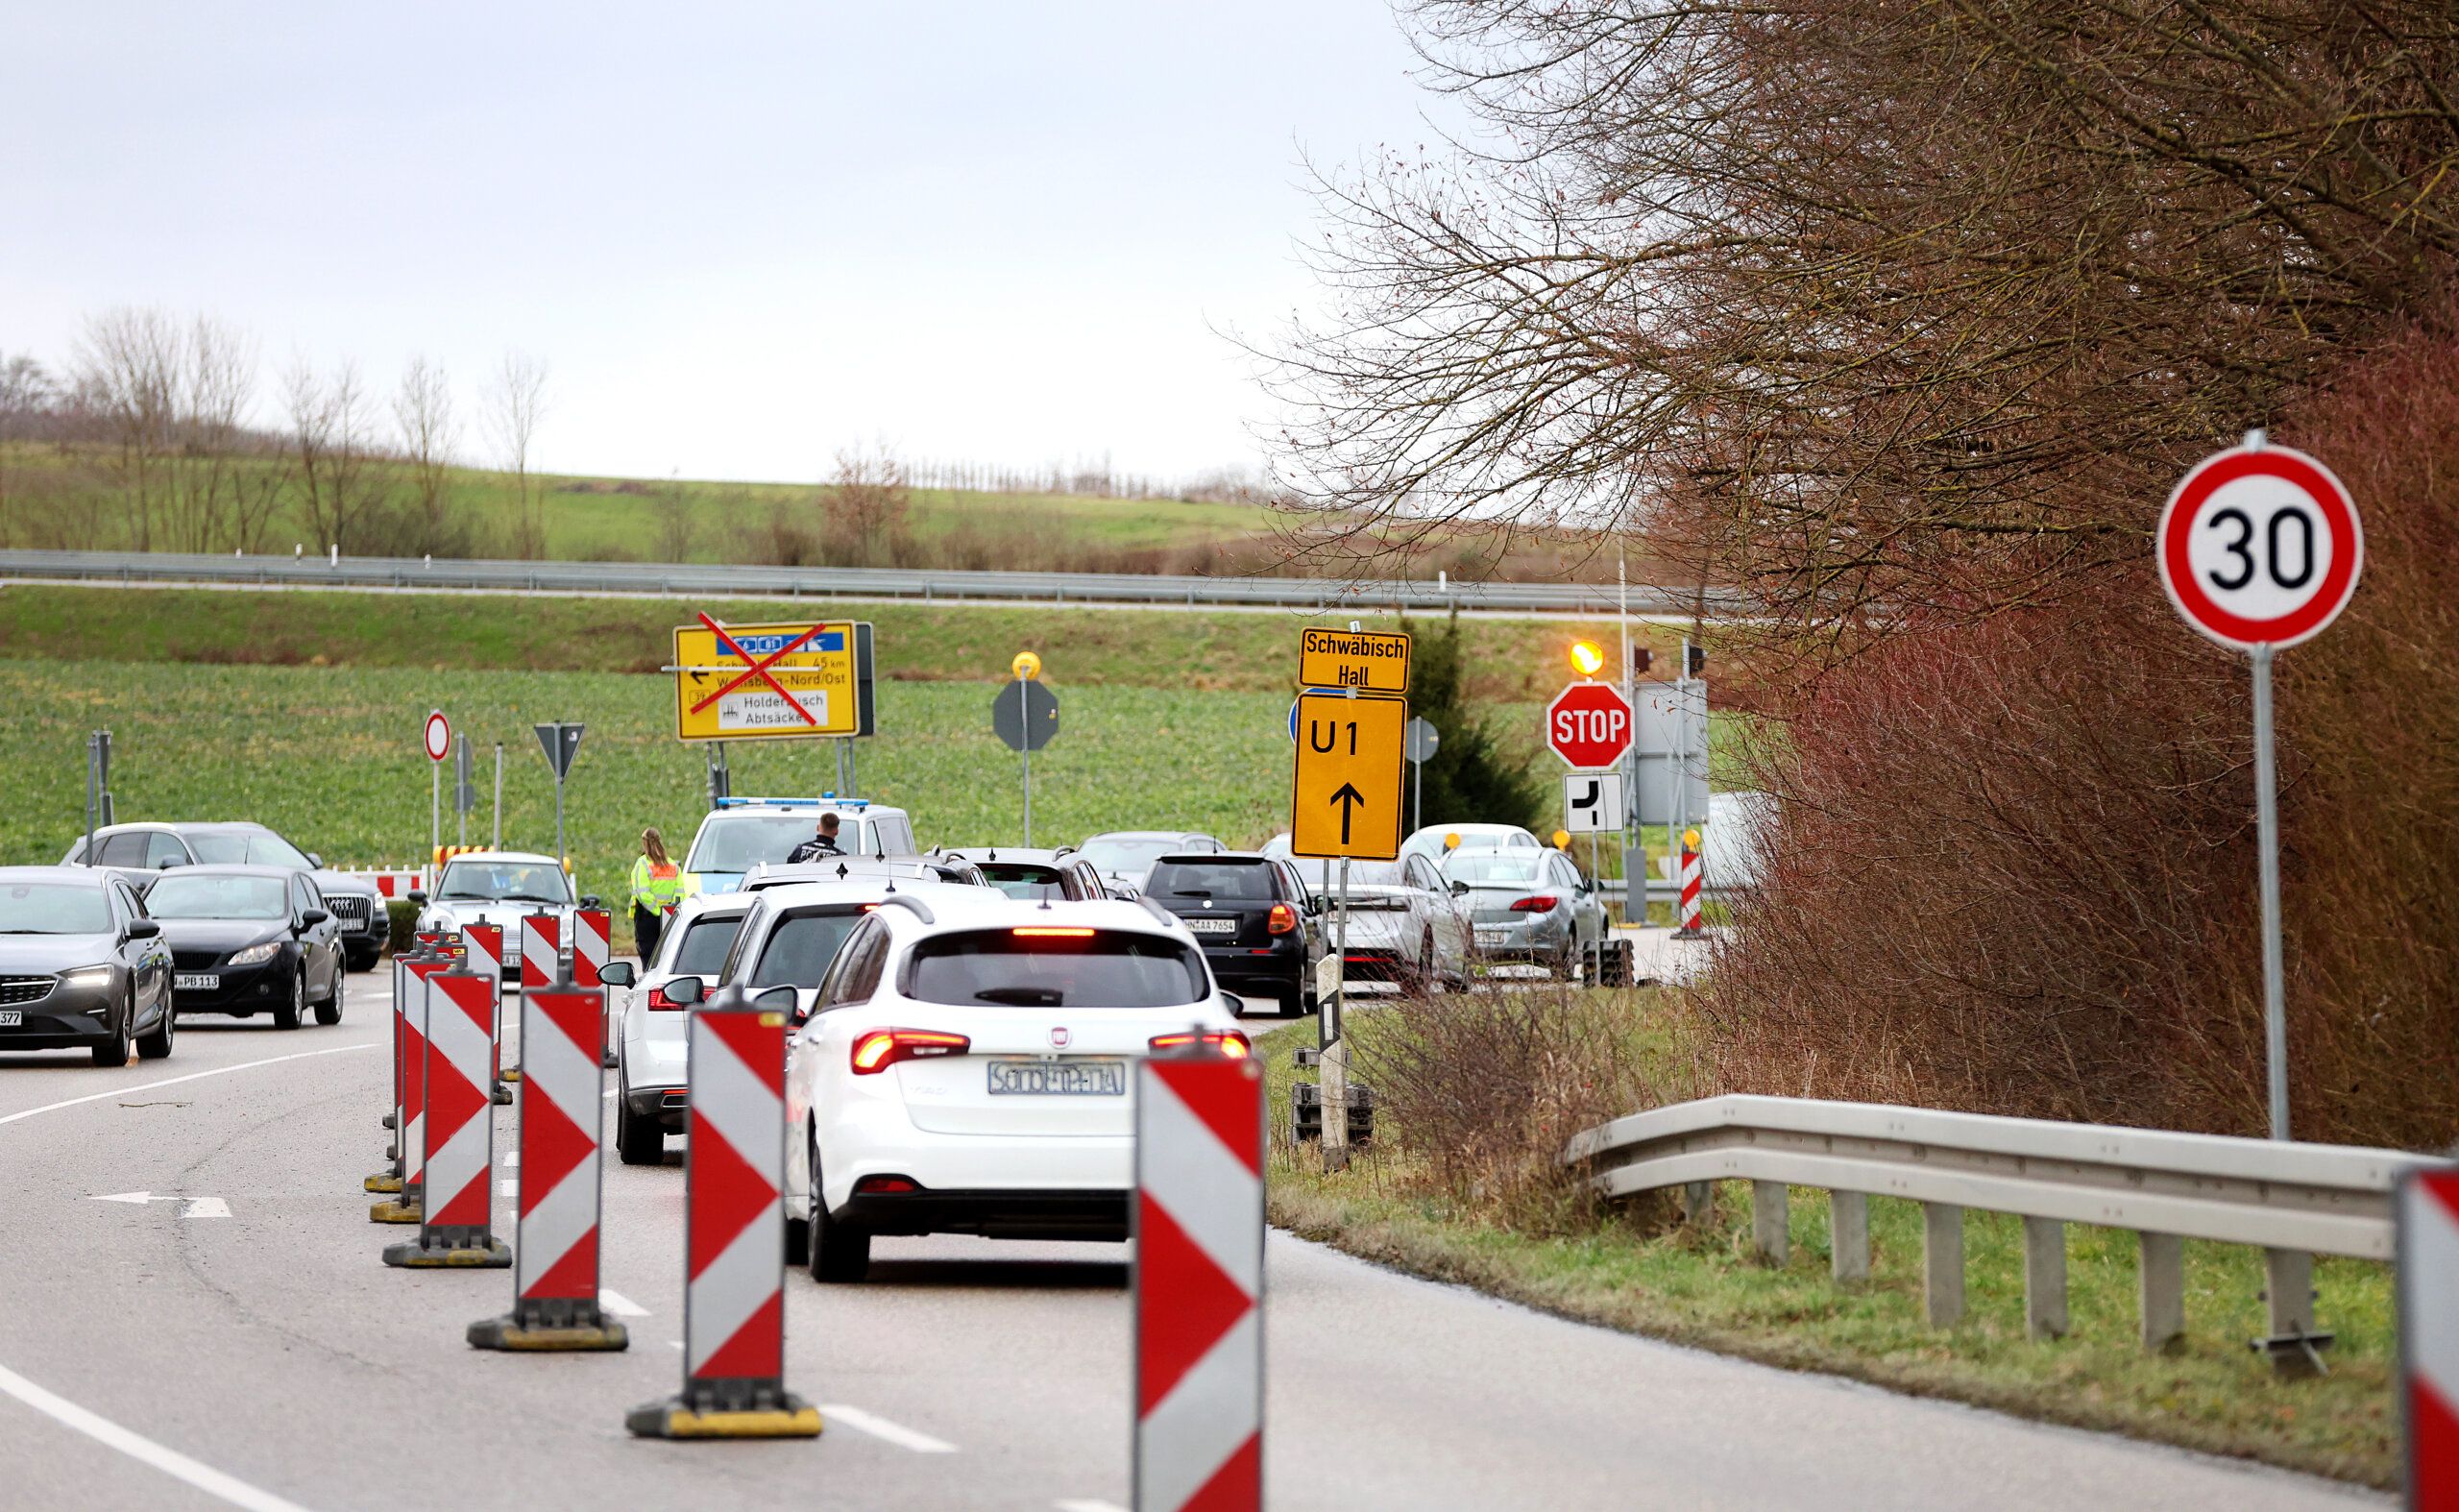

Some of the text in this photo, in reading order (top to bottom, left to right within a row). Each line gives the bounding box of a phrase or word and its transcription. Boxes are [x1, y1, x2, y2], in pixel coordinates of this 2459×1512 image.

[2208, 506, 2314, 591] 30
[1306, 632, 1404, 659] Schwäbisch
[830, 659, 845, 669] km
[1338, 665, 1369, 686] Hall
[745, 711, 808, 725] Abtsäcke
[1556, 709, 1626, 744] STOP
[1213, 920, 1233, 931] 7654
[183, 976, 197, 987] PB
[199, 976, 218, 987] 113
[0, 1012, 20, 1024] 377
